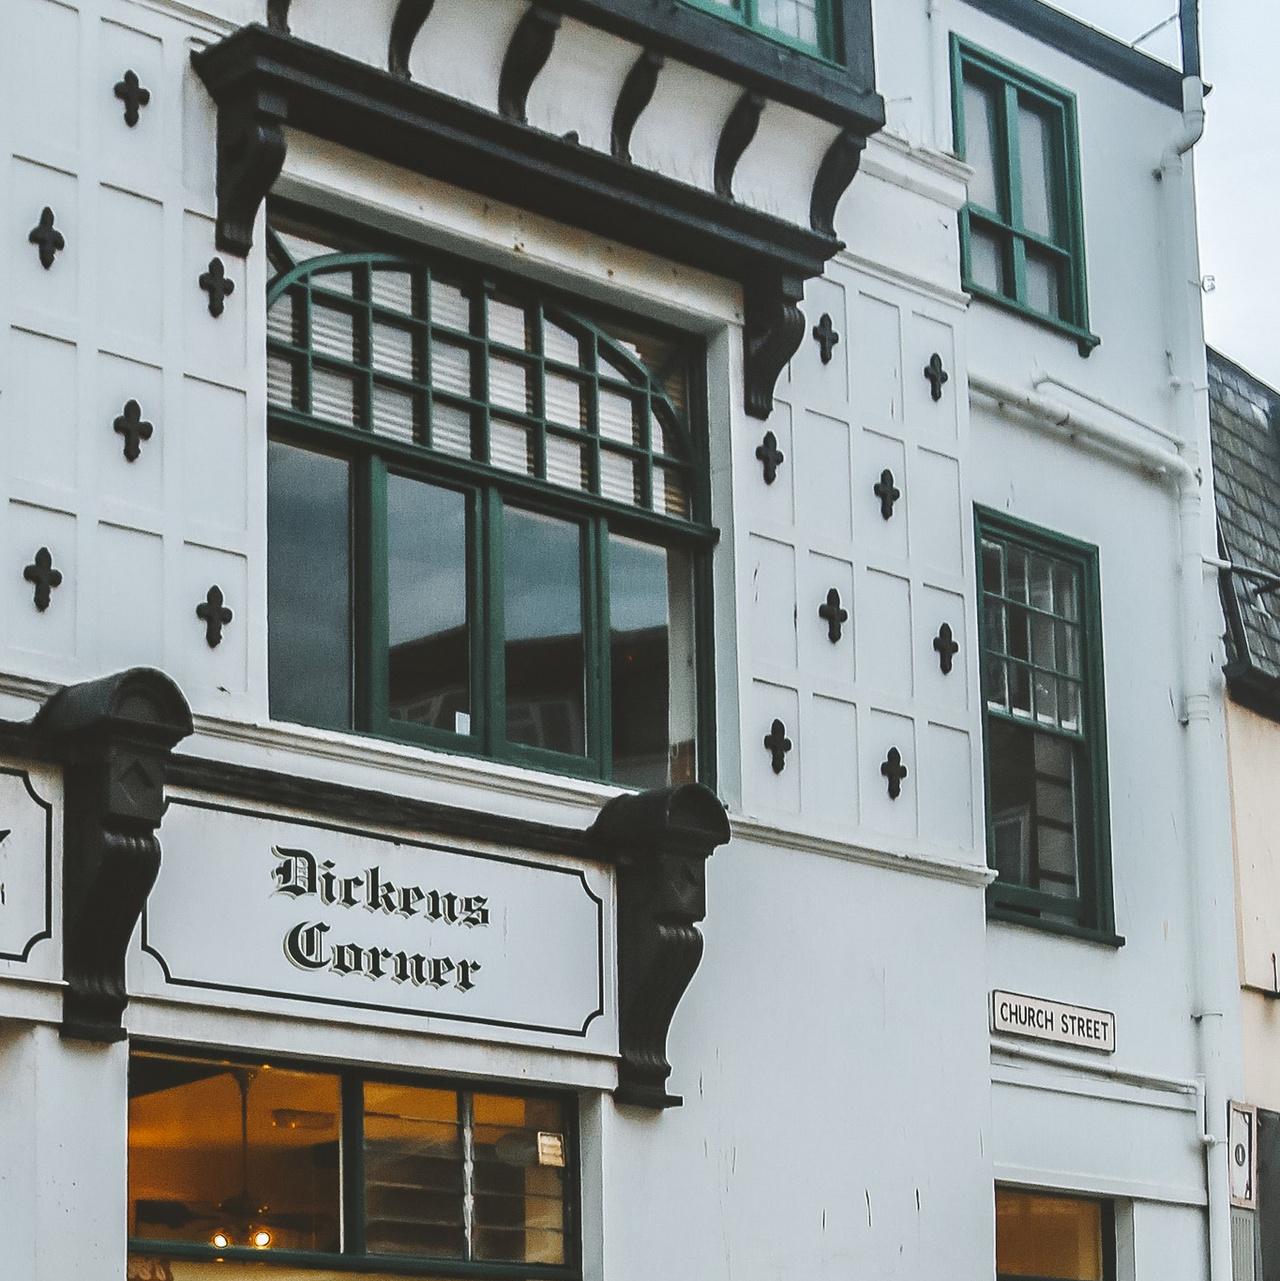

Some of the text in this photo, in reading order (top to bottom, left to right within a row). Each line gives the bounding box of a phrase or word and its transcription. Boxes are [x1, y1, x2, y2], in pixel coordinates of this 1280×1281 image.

[270, 843, 491, 928] Dickens
[283, 919, 483, 994] Corner
[1000, 1001, 1109, 1042] CHURCH STREET
